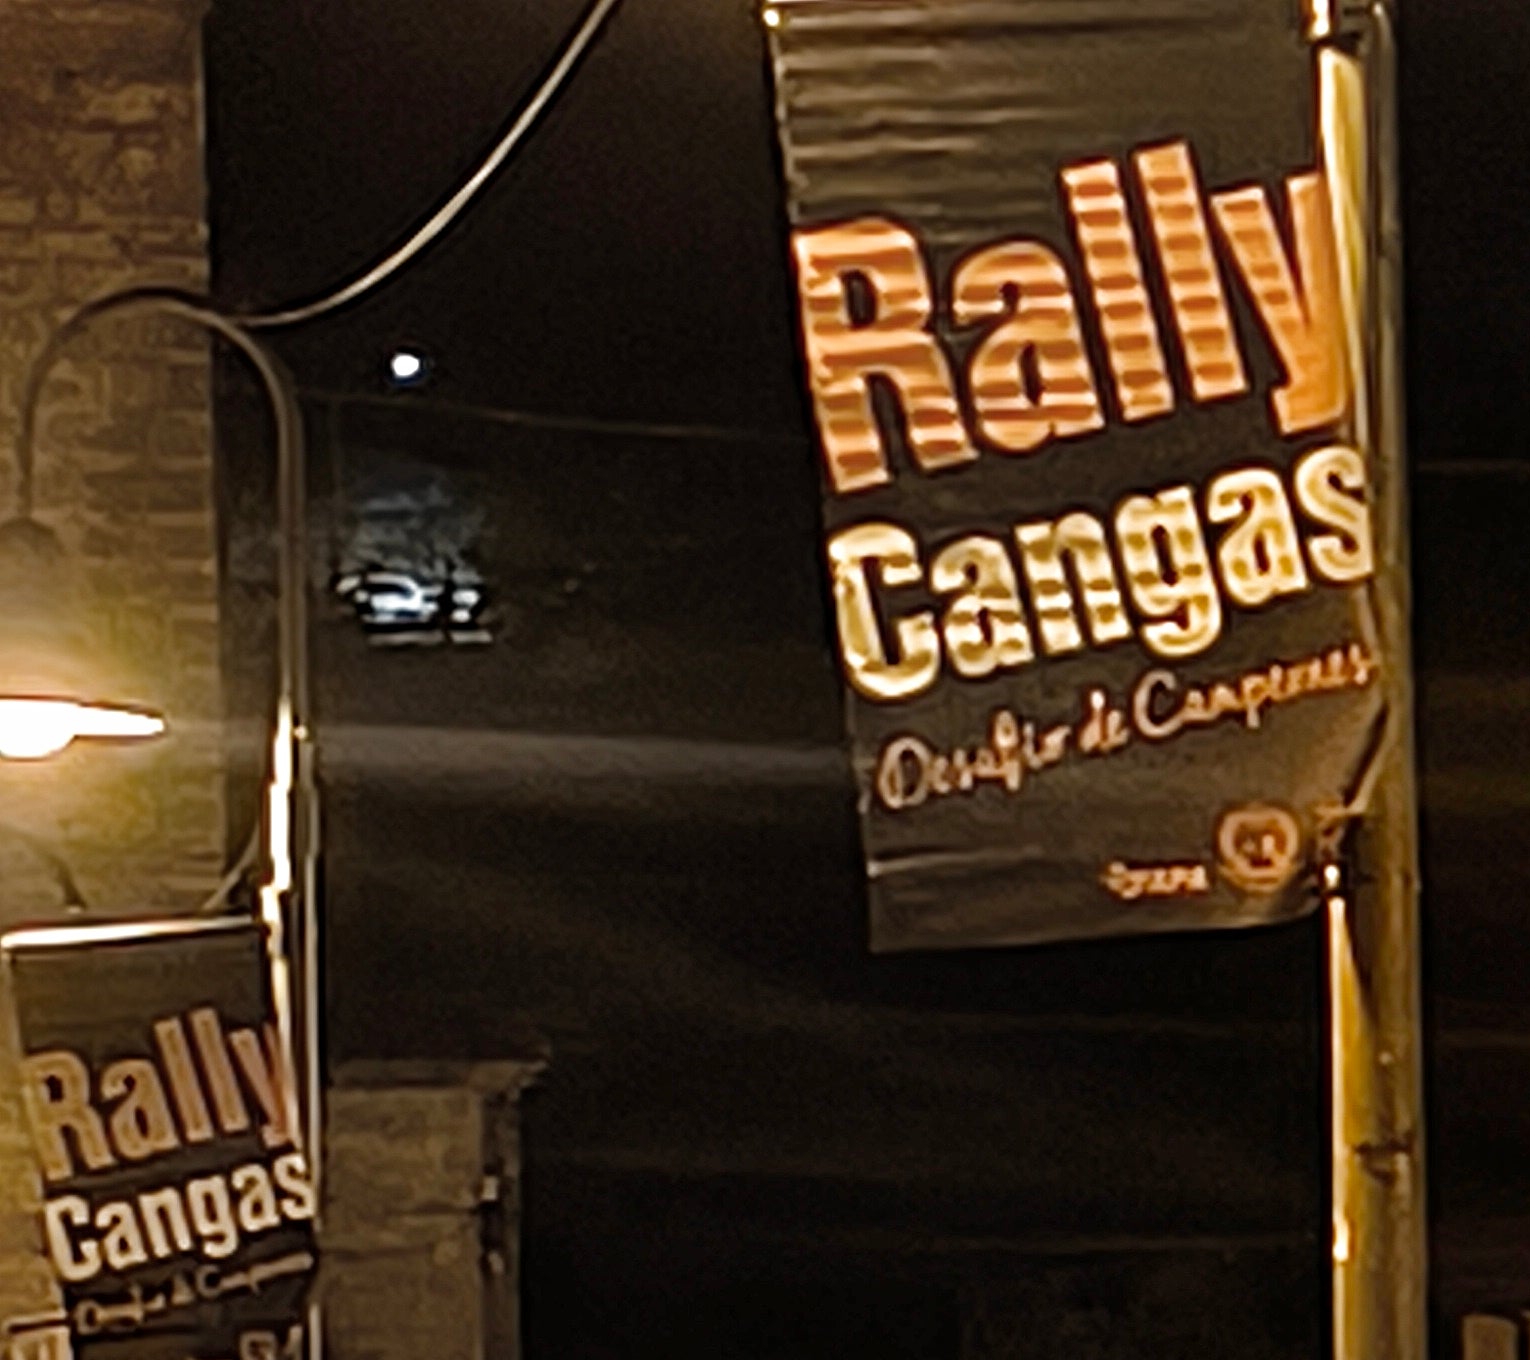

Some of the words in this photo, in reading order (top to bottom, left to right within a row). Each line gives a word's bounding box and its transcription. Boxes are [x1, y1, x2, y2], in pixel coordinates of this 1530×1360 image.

[794, 140, 1350, 494] Rally
[827, 445, 1375, 702] Cangas
[1079, 689, 1130, 752] de
[22, 1007, 294, 1182] Rally
[45, 1152, 315, 1282] Cangas
